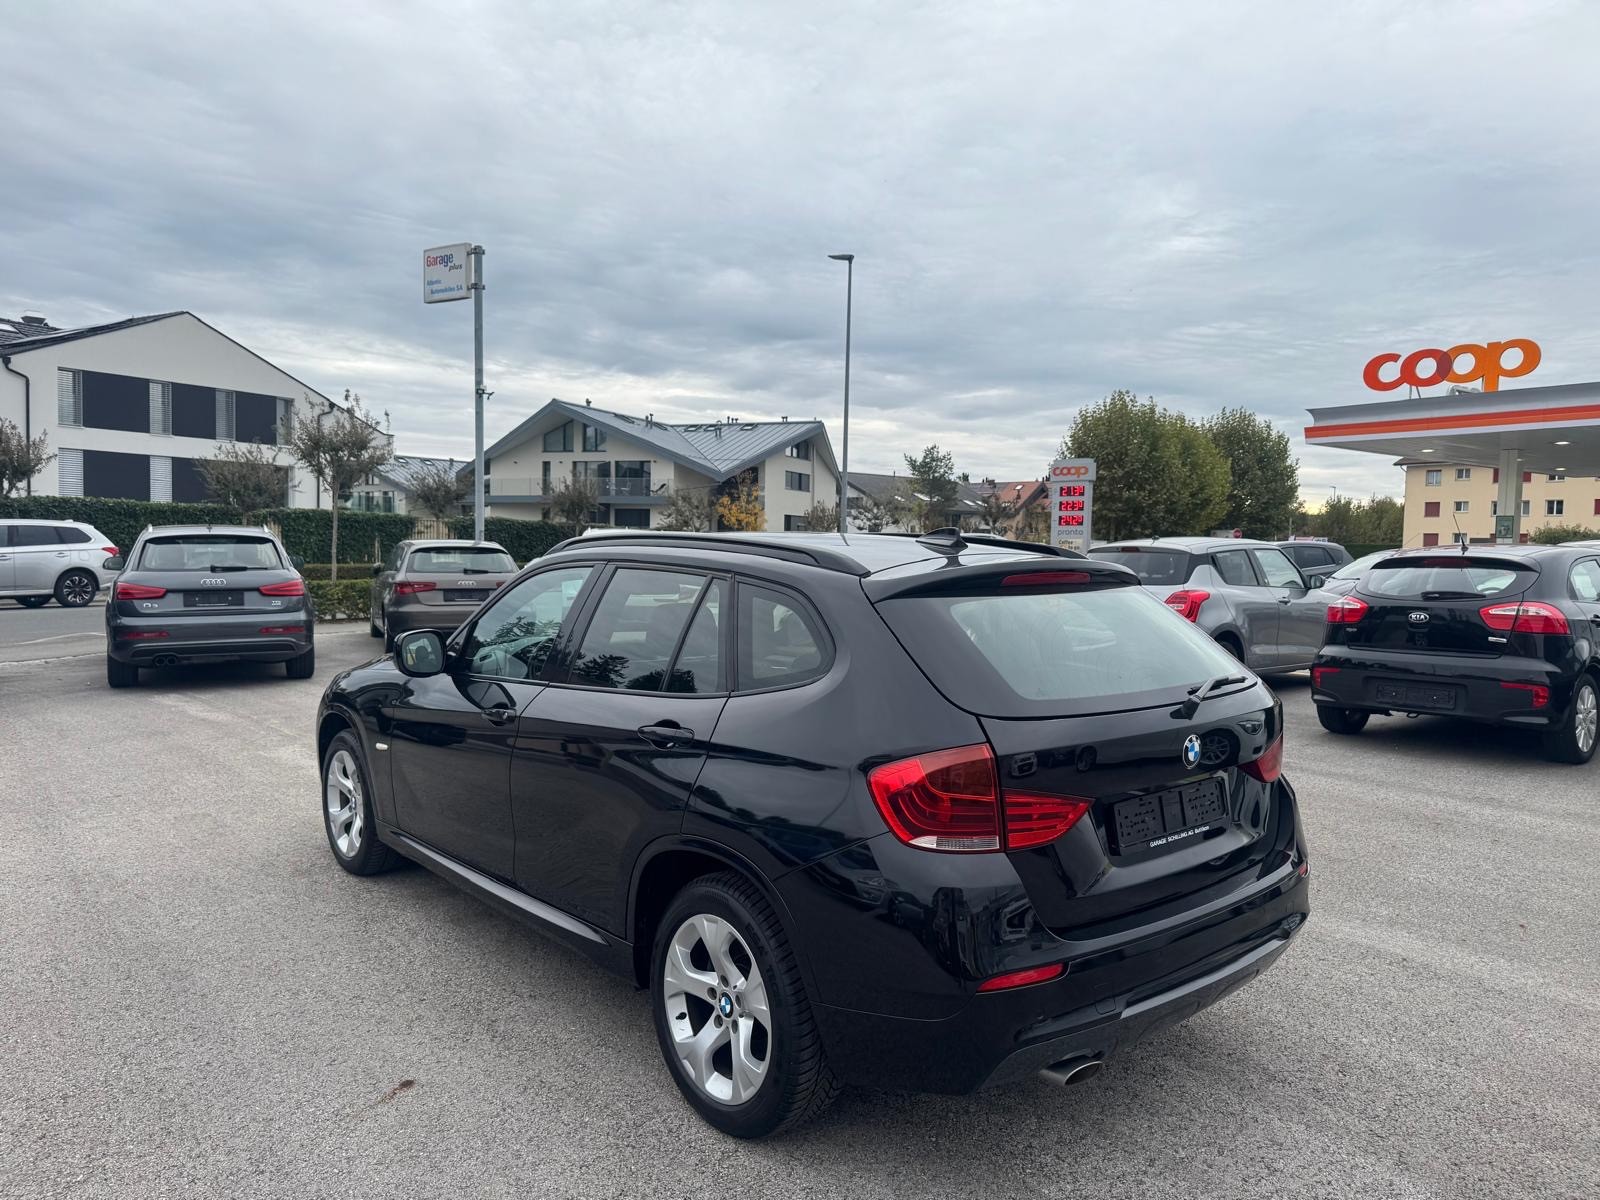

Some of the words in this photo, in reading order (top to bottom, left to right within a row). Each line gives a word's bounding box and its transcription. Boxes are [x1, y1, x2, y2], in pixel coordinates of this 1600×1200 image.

[426, 253, 454, 267] Garage
[448, 263, 463, 272] plus
[1363, 338, 1542, 393] coop
[1052, 466, 1089, 478] coop
[1149, 838, 1167, 847] GARAGE
